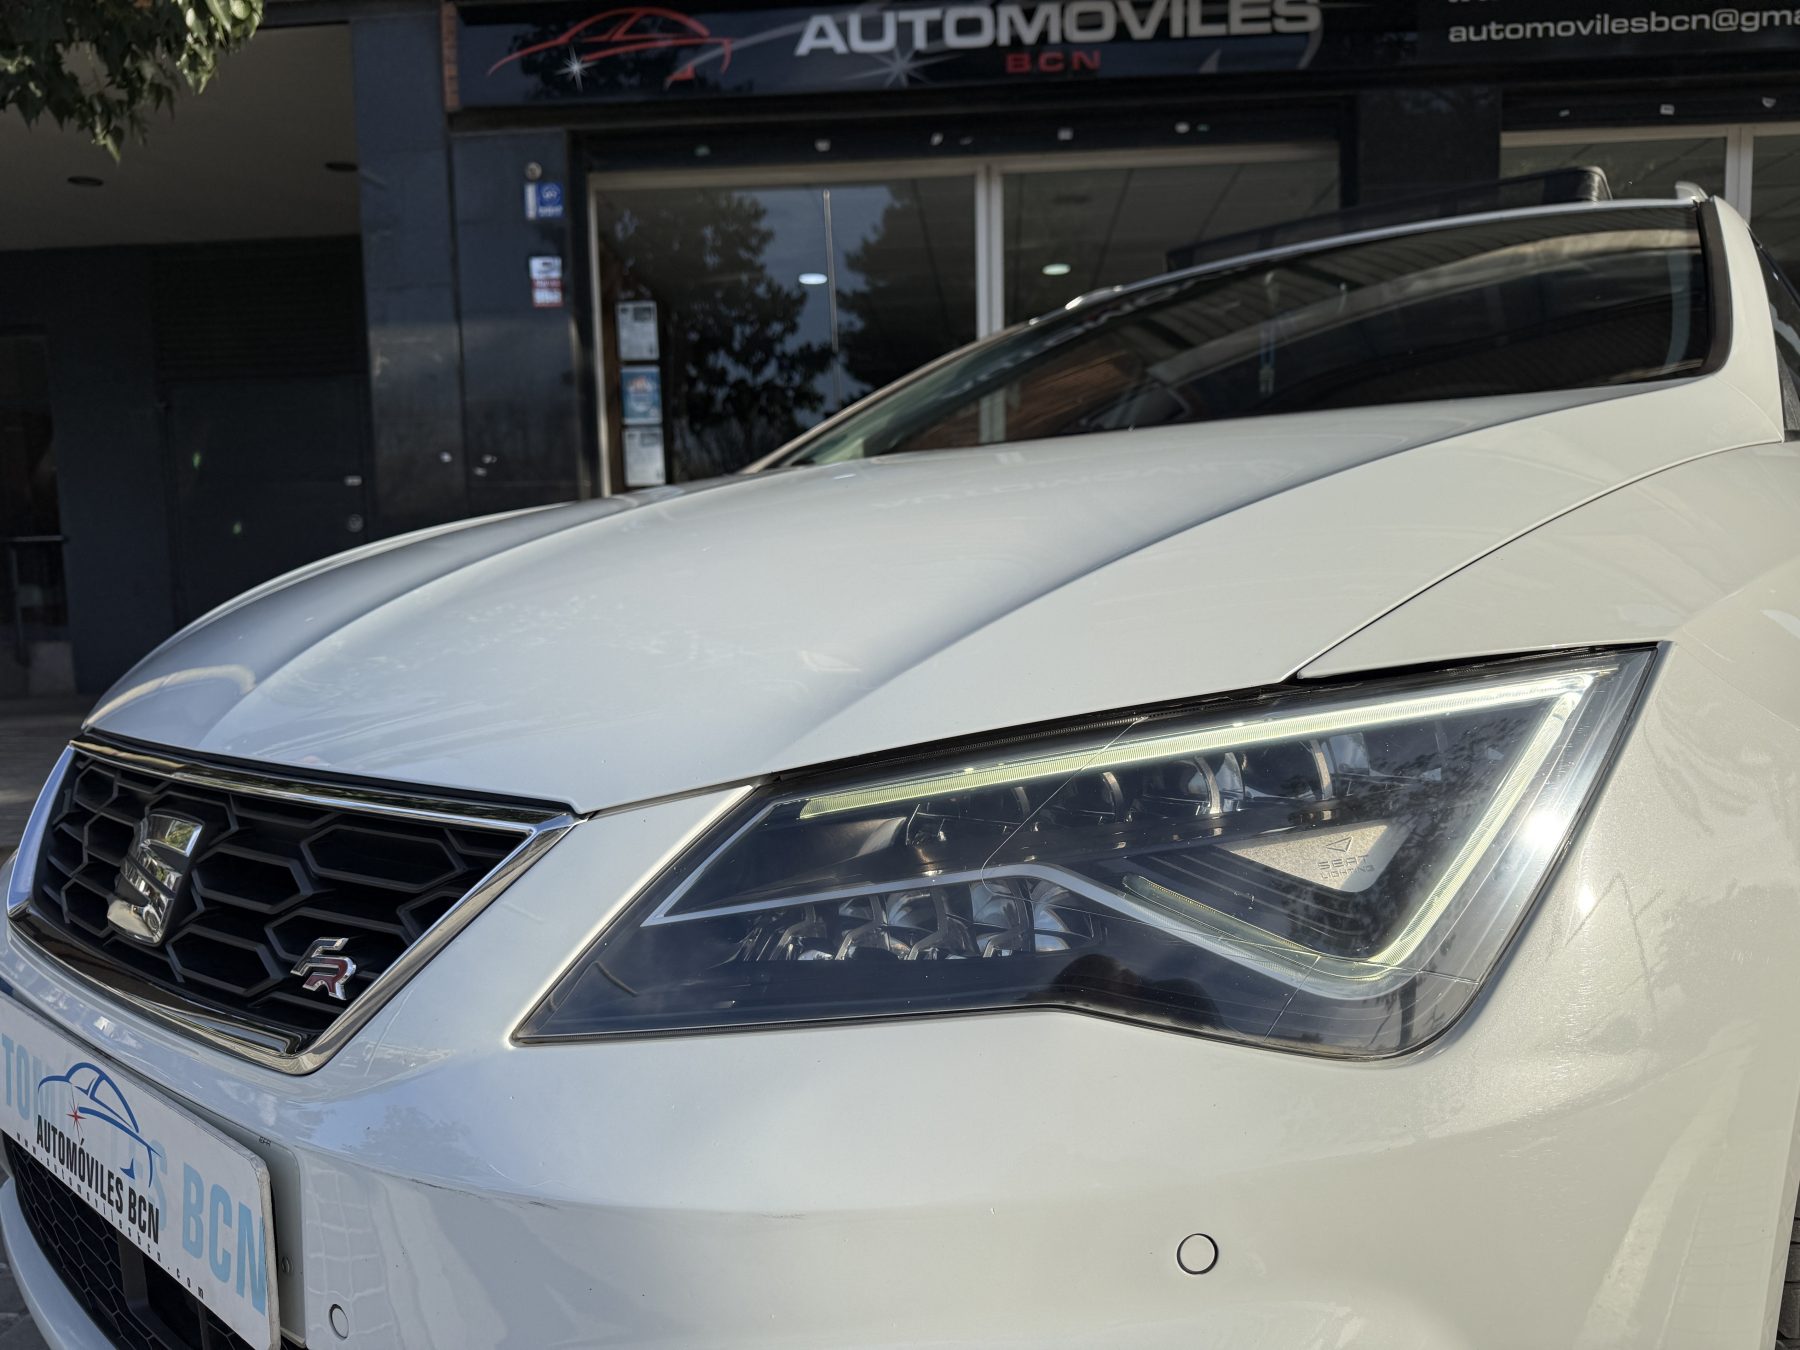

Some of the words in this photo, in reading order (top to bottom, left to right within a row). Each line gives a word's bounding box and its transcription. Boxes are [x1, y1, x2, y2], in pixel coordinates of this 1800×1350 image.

[794, 0, 1322, 57] AUTOMOVILES
[1005, 50, 1101, 74] BCN
[1318, 854, 1369, 870] SEAT
[1320, 864, 1376, 879] LIGHTING
[290, 936, 357, 1001] FR
[36, 1114, 124, 1215] AUTOMÓVILES
[128, 1185, 160, 1245] BCN
[182, 1161, 267, 1317] BCN
